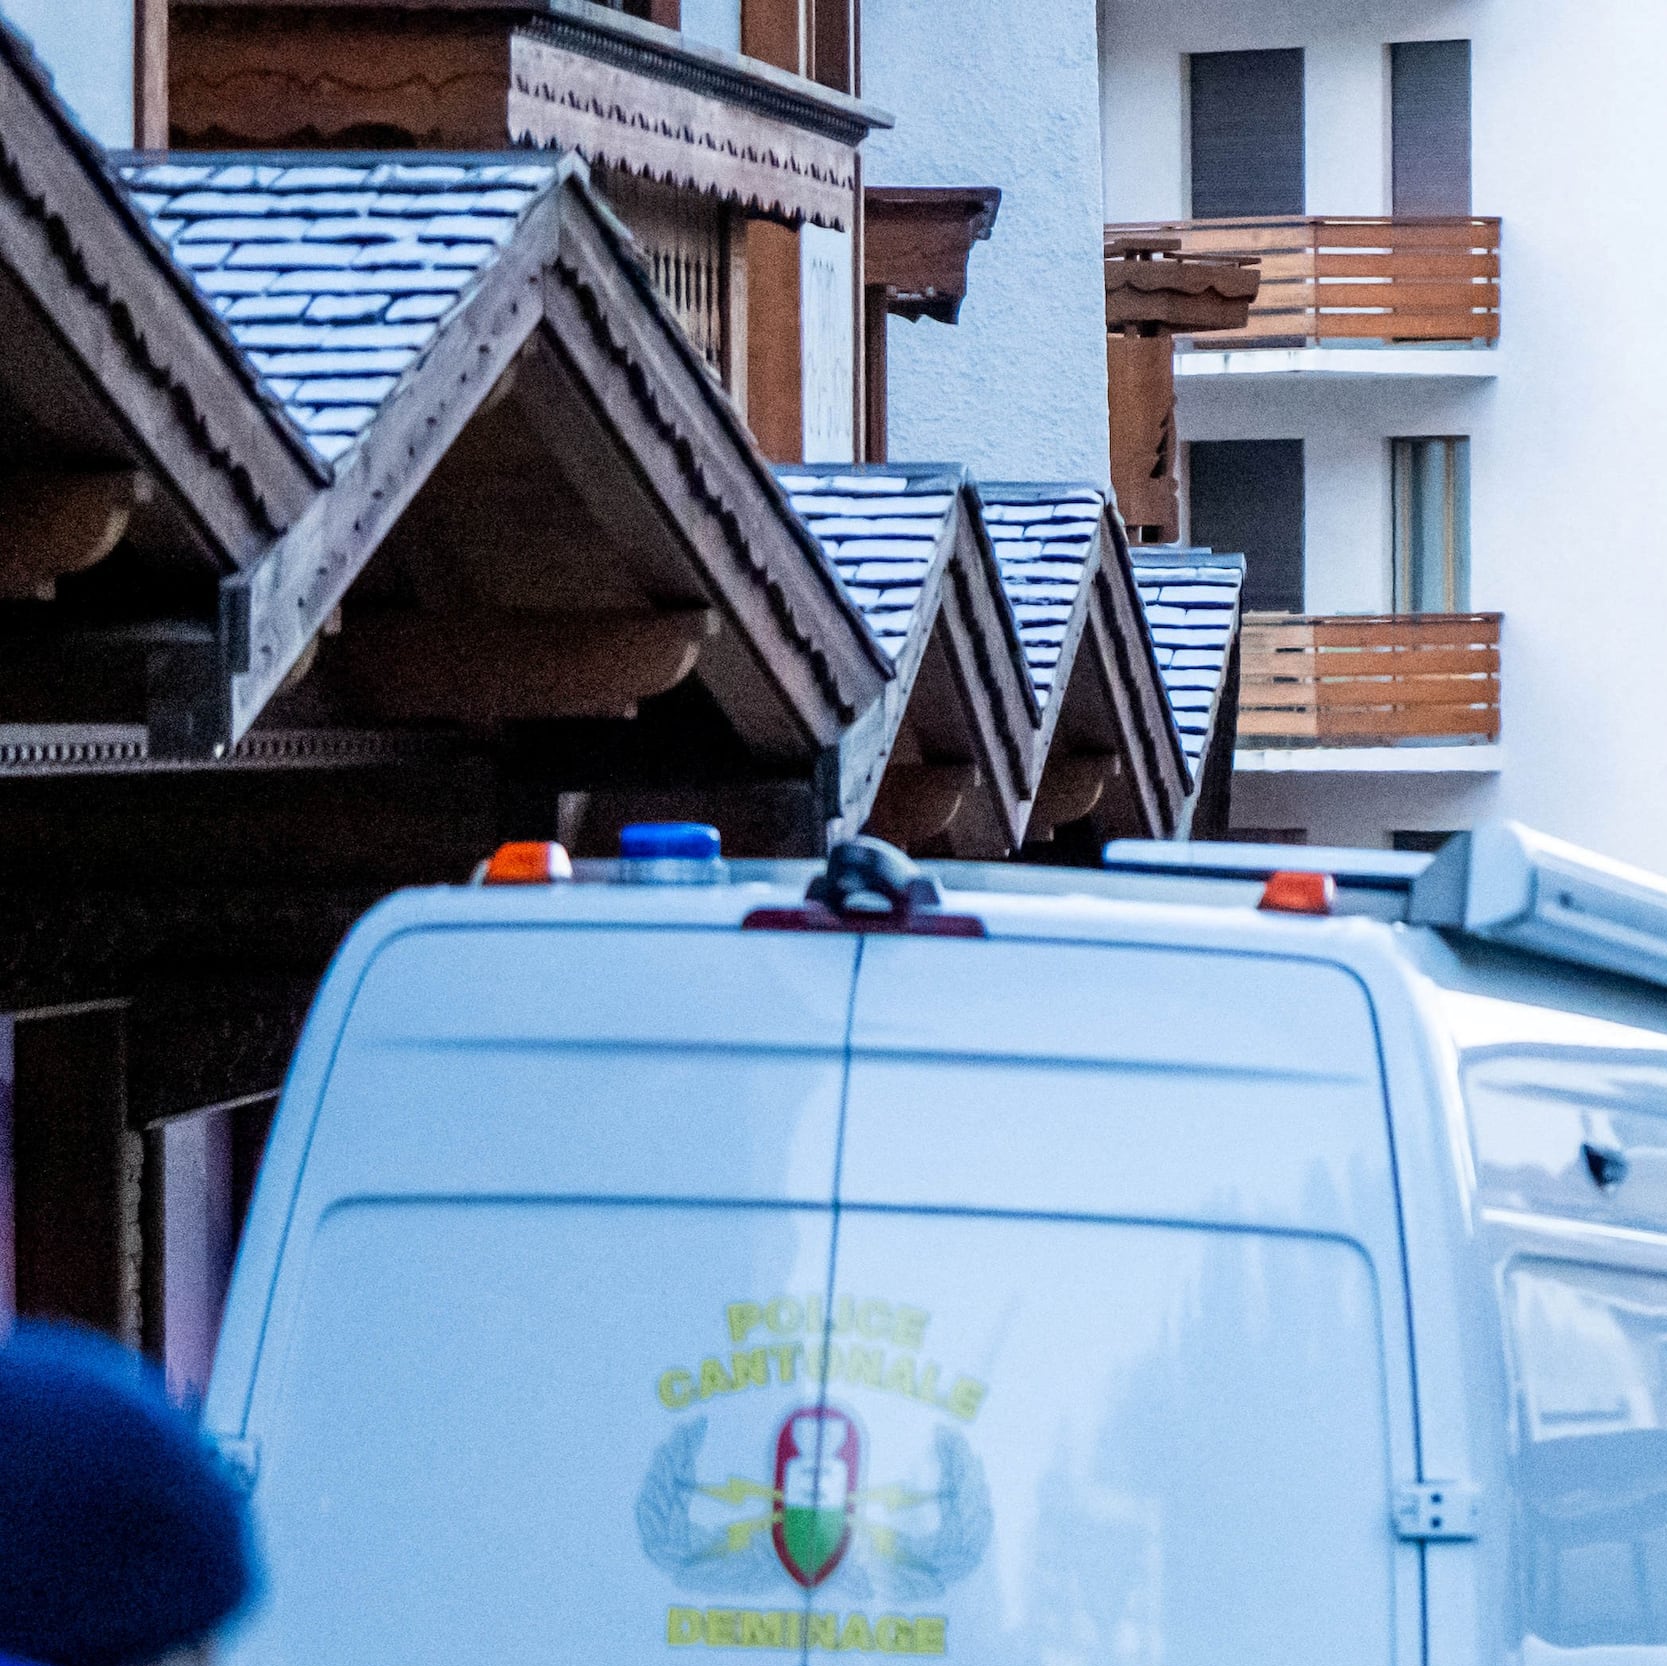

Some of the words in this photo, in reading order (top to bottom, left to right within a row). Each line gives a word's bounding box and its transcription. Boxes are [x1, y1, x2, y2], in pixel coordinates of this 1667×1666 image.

[726, 1295, 931, 1346] POLICE
[657, 1341, 986, 1420] CANTONALE
[667, 1606, 947, 1656] DEMINAGE
